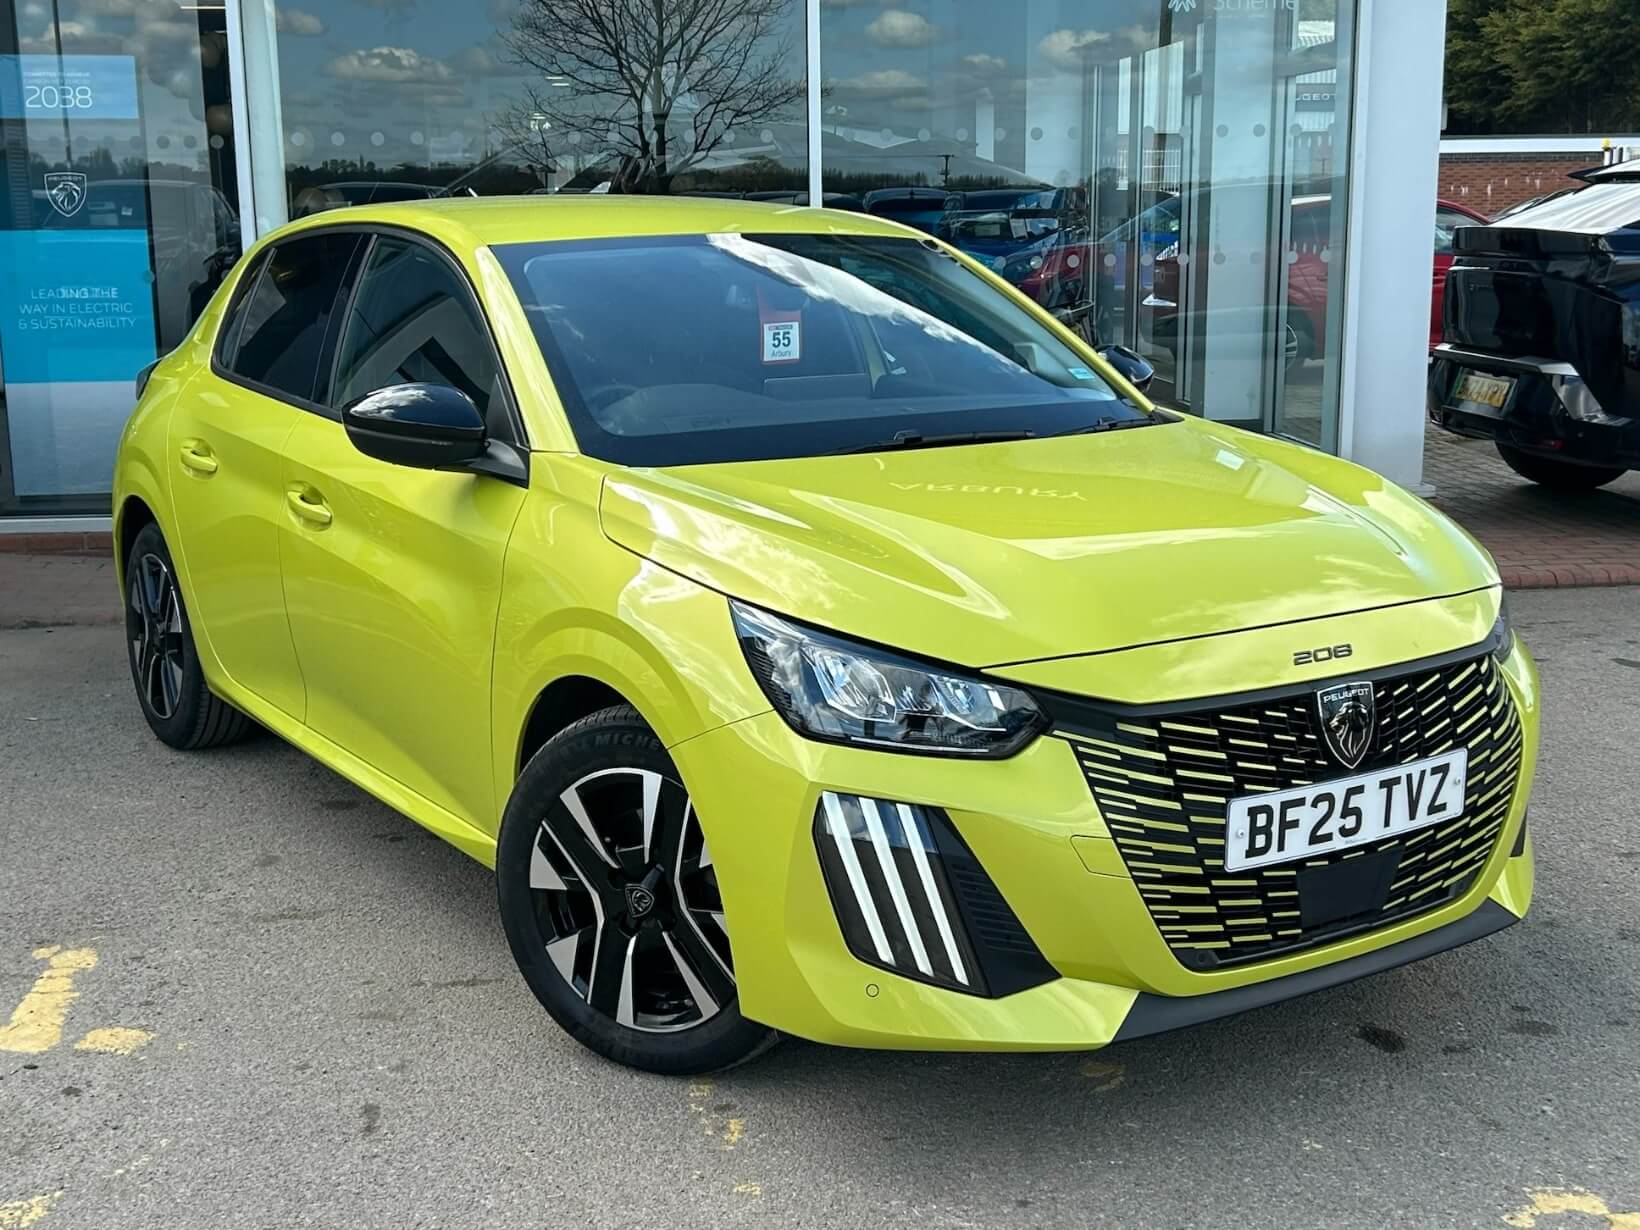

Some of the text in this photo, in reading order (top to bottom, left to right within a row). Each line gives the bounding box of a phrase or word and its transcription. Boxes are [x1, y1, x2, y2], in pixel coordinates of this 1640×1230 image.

[25, 85, 93, 108] 2038
[31, 287, 119, 299] LEADING THE
[19, 302, 133, 314] WAY IN ELECTRIC
[18, 317, 136, 330] & SUSTAINABILITY
[772, 331, 791, 348] 55
[1293, 643, 1353, 666] 208
[1323, 687, 1369, 703] PEUGEOT
[1244, 762, 1450, 859] BF25 TVZ
